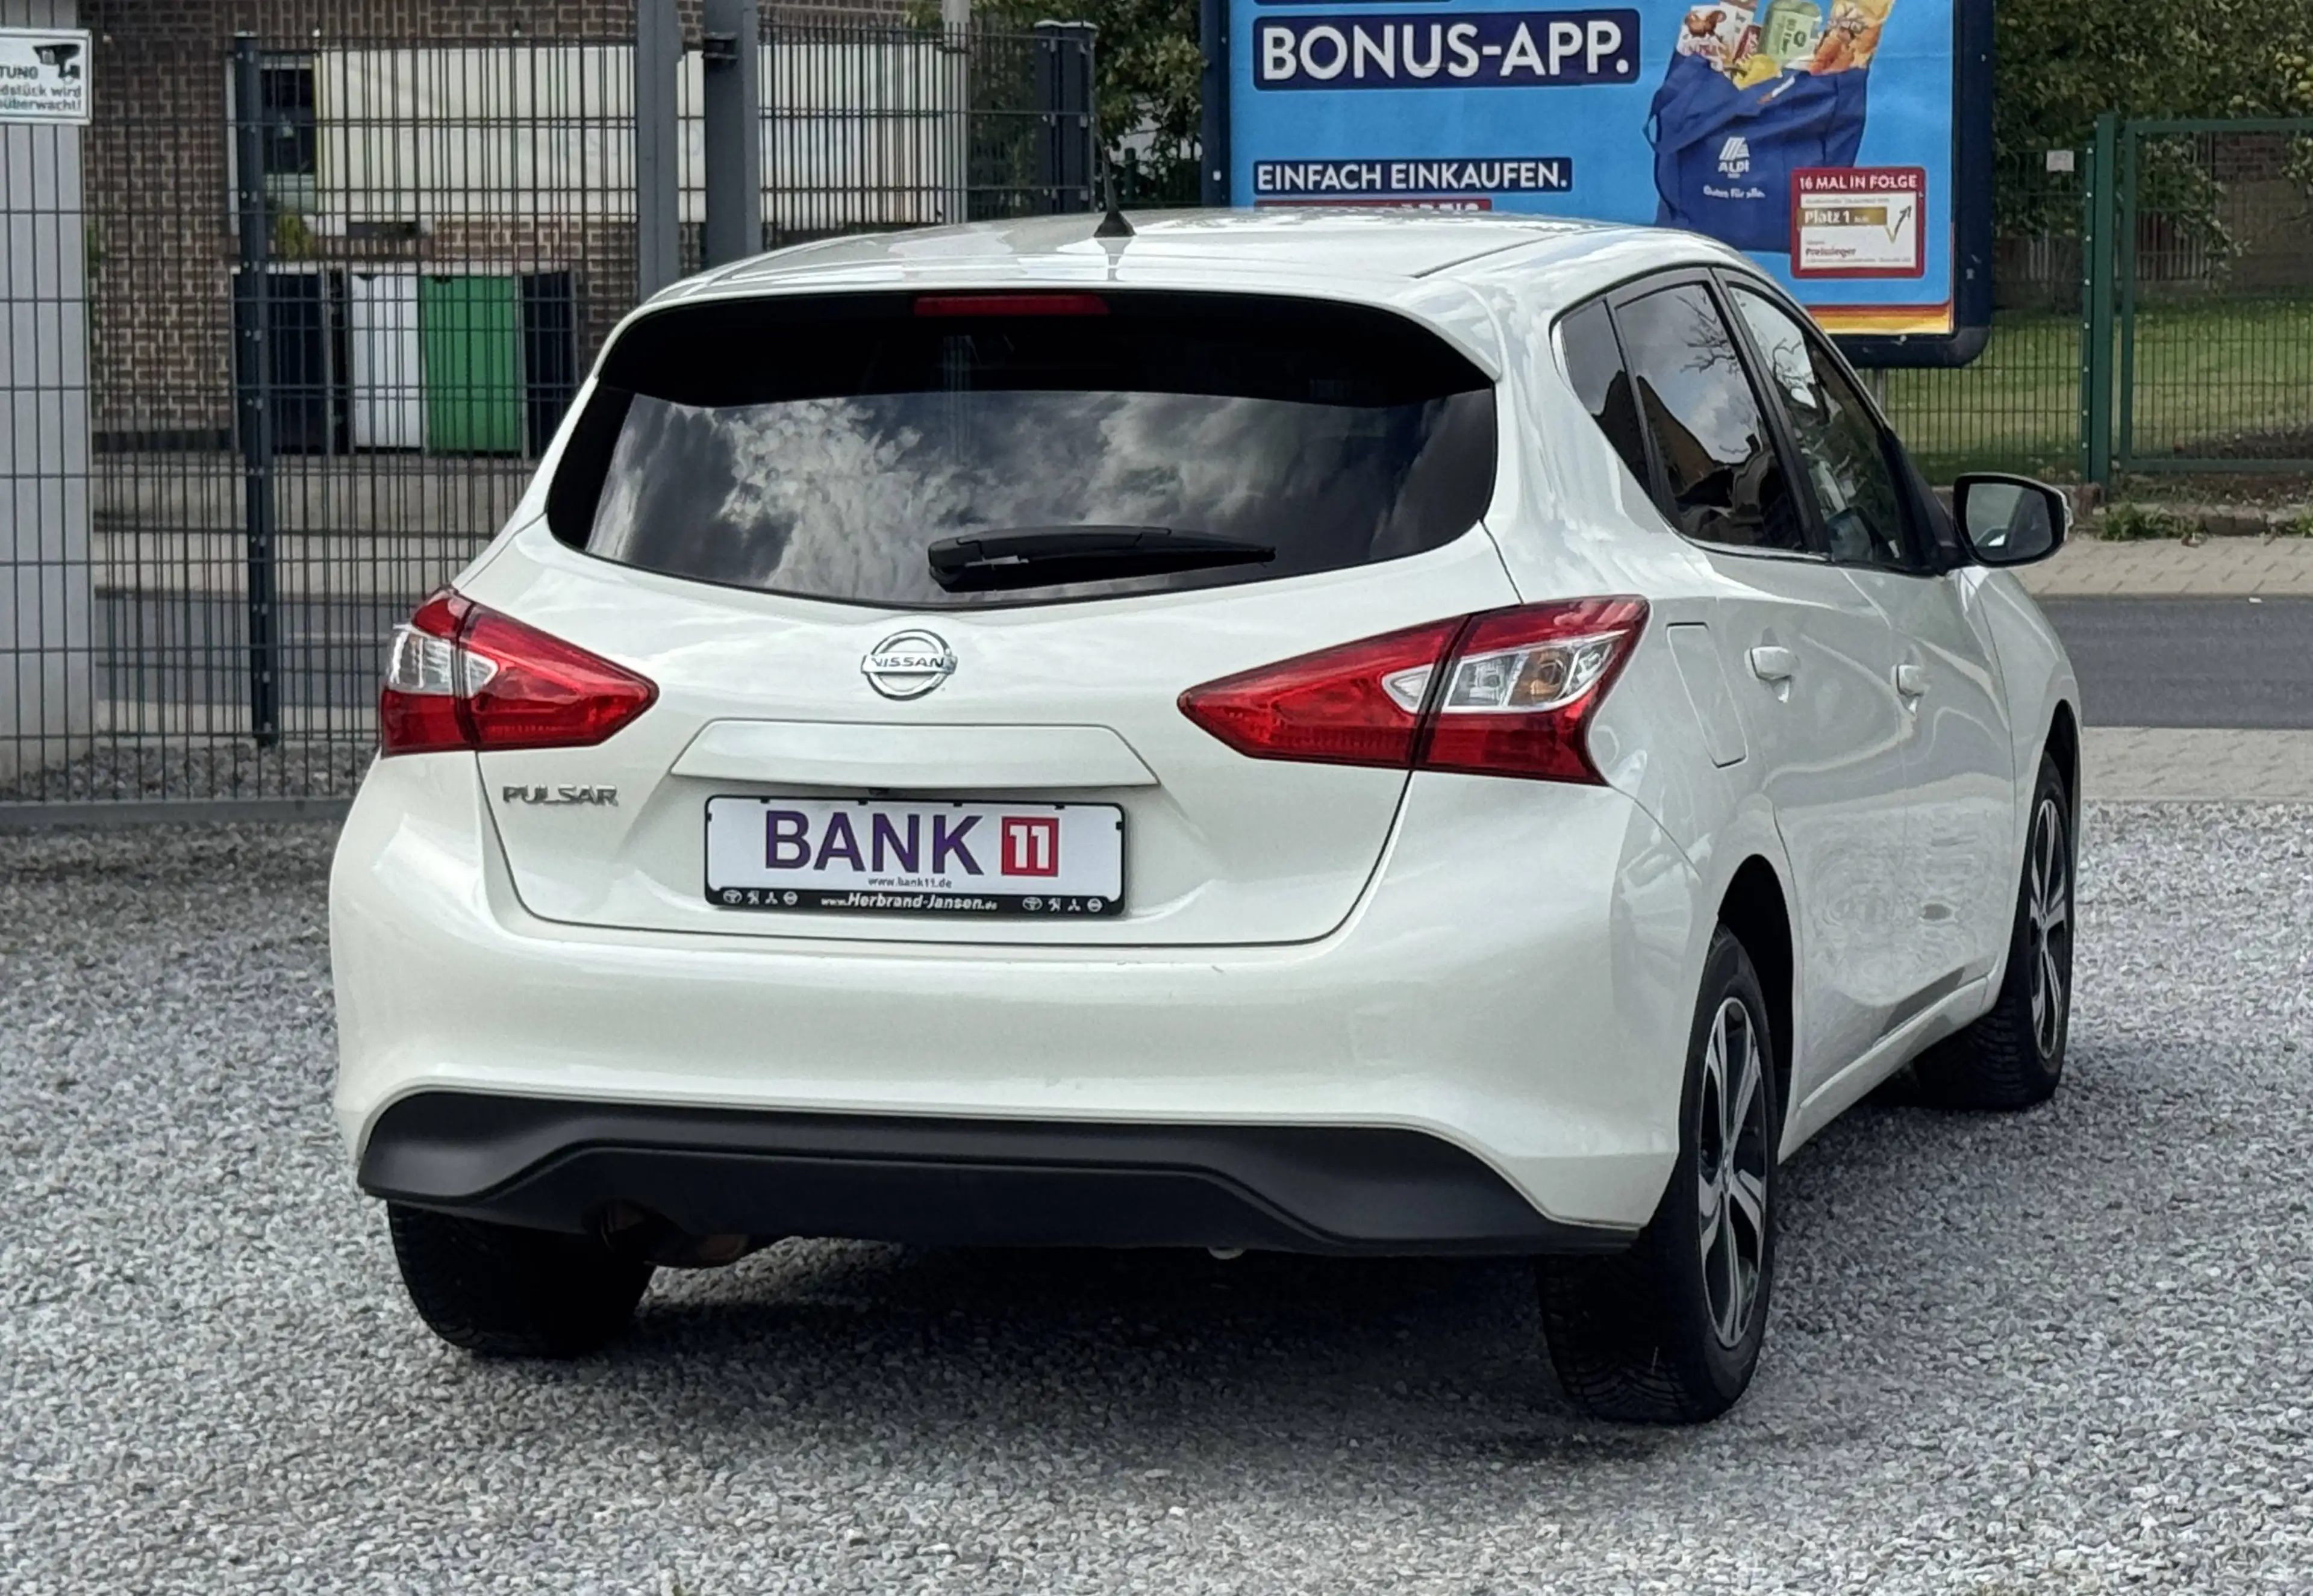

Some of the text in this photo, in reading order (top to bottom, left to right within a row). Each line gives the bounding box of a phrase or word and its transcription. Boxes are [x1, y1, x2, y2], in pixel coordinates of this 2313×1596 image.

[1263, 21, 1629, 80] BONUS-APP.
[51, 85, 81, 97] wird
[1717, 159, 1750, 173] ALDI
[1258, 162, 1568, 190] EINFACH EINKAUFEN.
[1815, 175, 1847, 190] MAL
[1850, 175, 1866, 189] IN
[1869, 174, 1918, 189] FOLGE
[1805, 210, 1841, 223] Platz
[1843, 210, 1850, 223] 1
[871, 656, 945, 667] NISSAN
[502, 785, 619, 806] PULSAR
[766, 809, 1050, 876] BANK 11
[868, 876, 952, 889] www.bank11.de
[821, 891, 997, 910] www.Herbrand-Jansen.de
